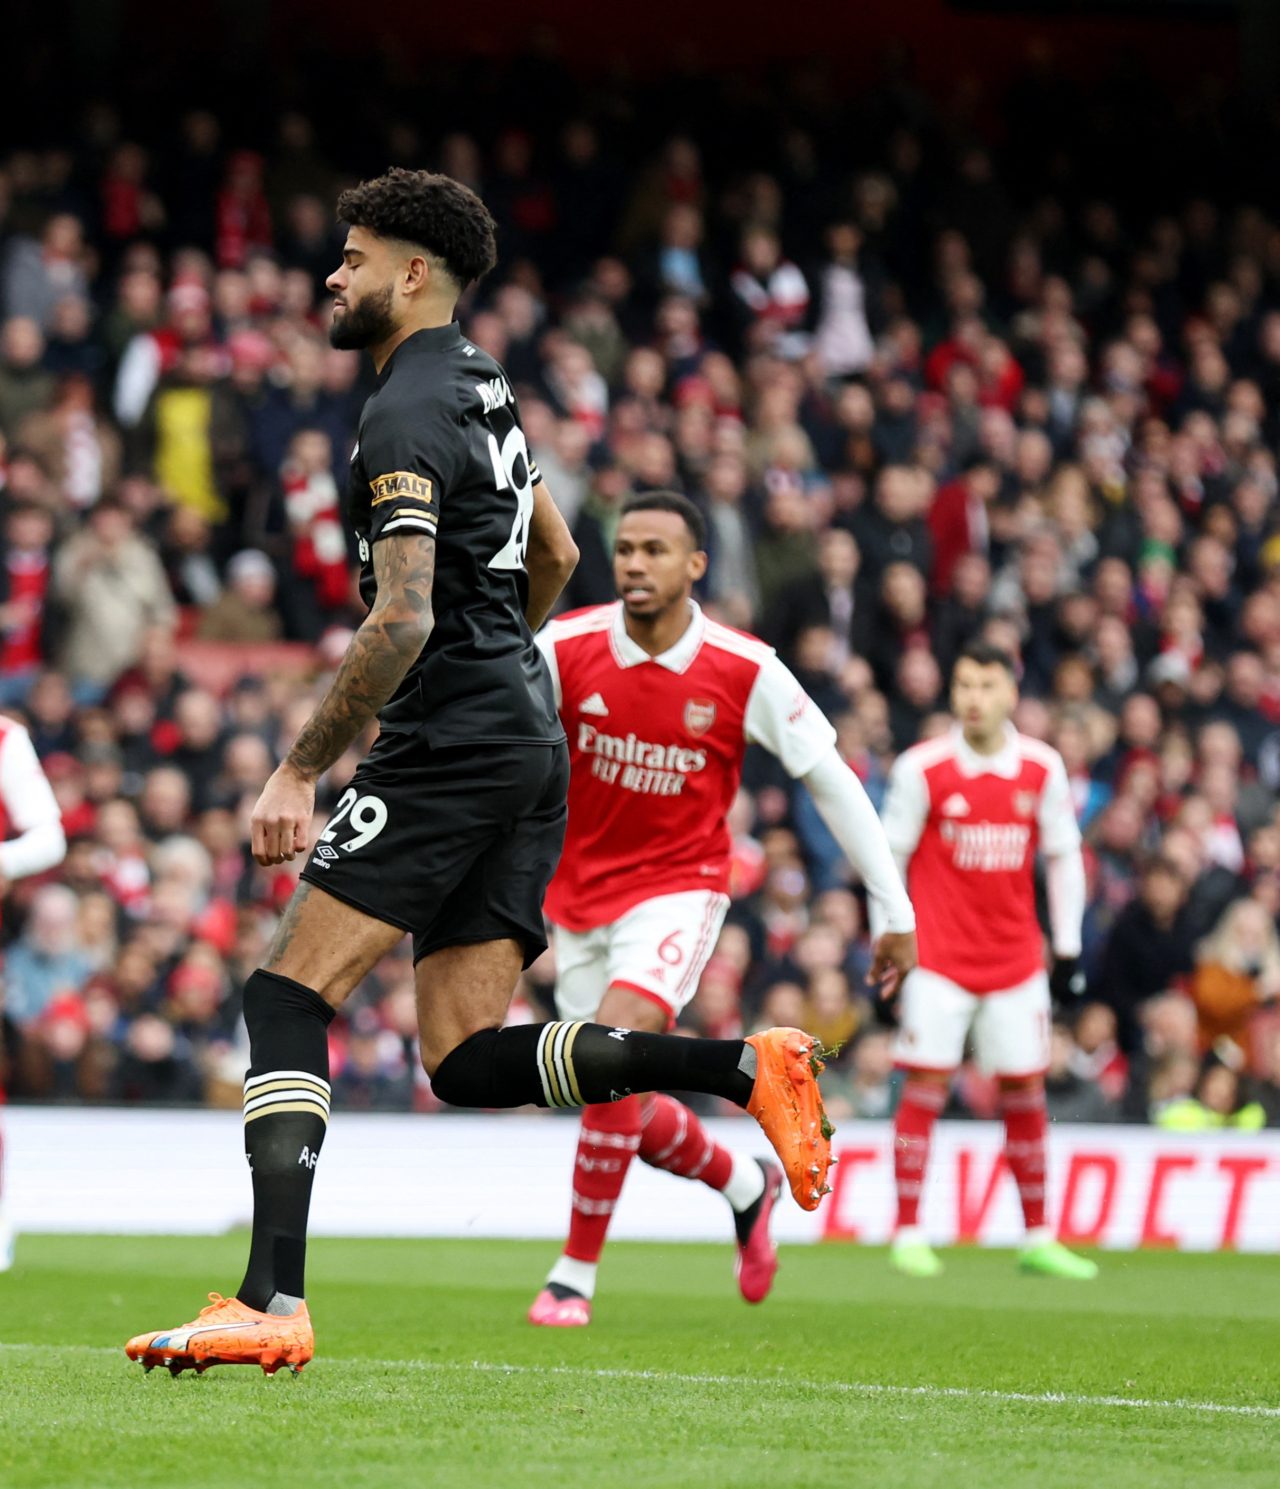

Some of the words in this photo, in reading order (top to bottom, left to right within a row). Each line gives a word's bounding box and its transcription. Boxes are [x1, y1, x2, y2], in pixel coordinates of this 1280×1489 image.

[578, 722, 707, 773] Emirates
[592, 756, 620, 785] FLY
[620, 764, 686, 796] BETTER
[320, 787, 398, 853] 29
[657, 928, 683, 967] 6
